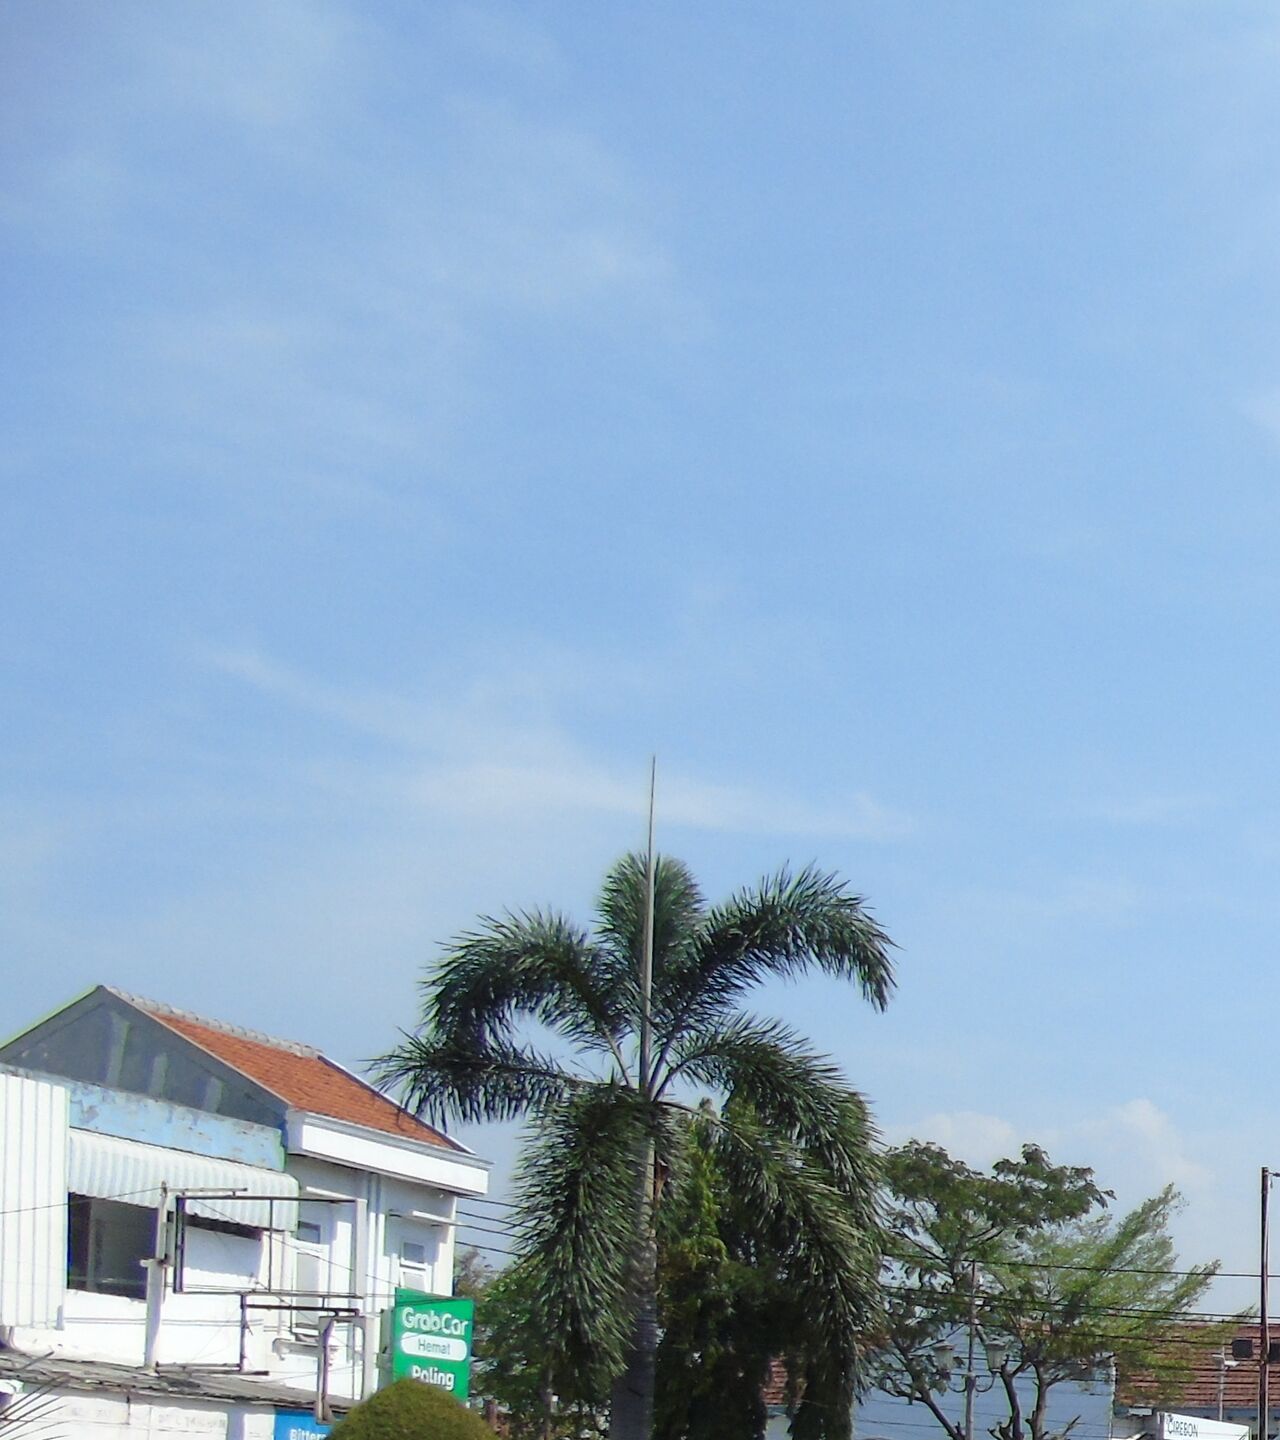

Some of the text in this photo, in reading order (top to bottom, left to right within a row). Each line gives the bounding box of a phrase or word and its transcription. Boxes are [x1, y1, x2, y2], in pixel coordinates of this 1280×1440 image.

[402, 1306, 468, 1335] GrabCar
[418, 1338, 451, 1355] Hemat
[412, 1365, 455, 1391] Paling
